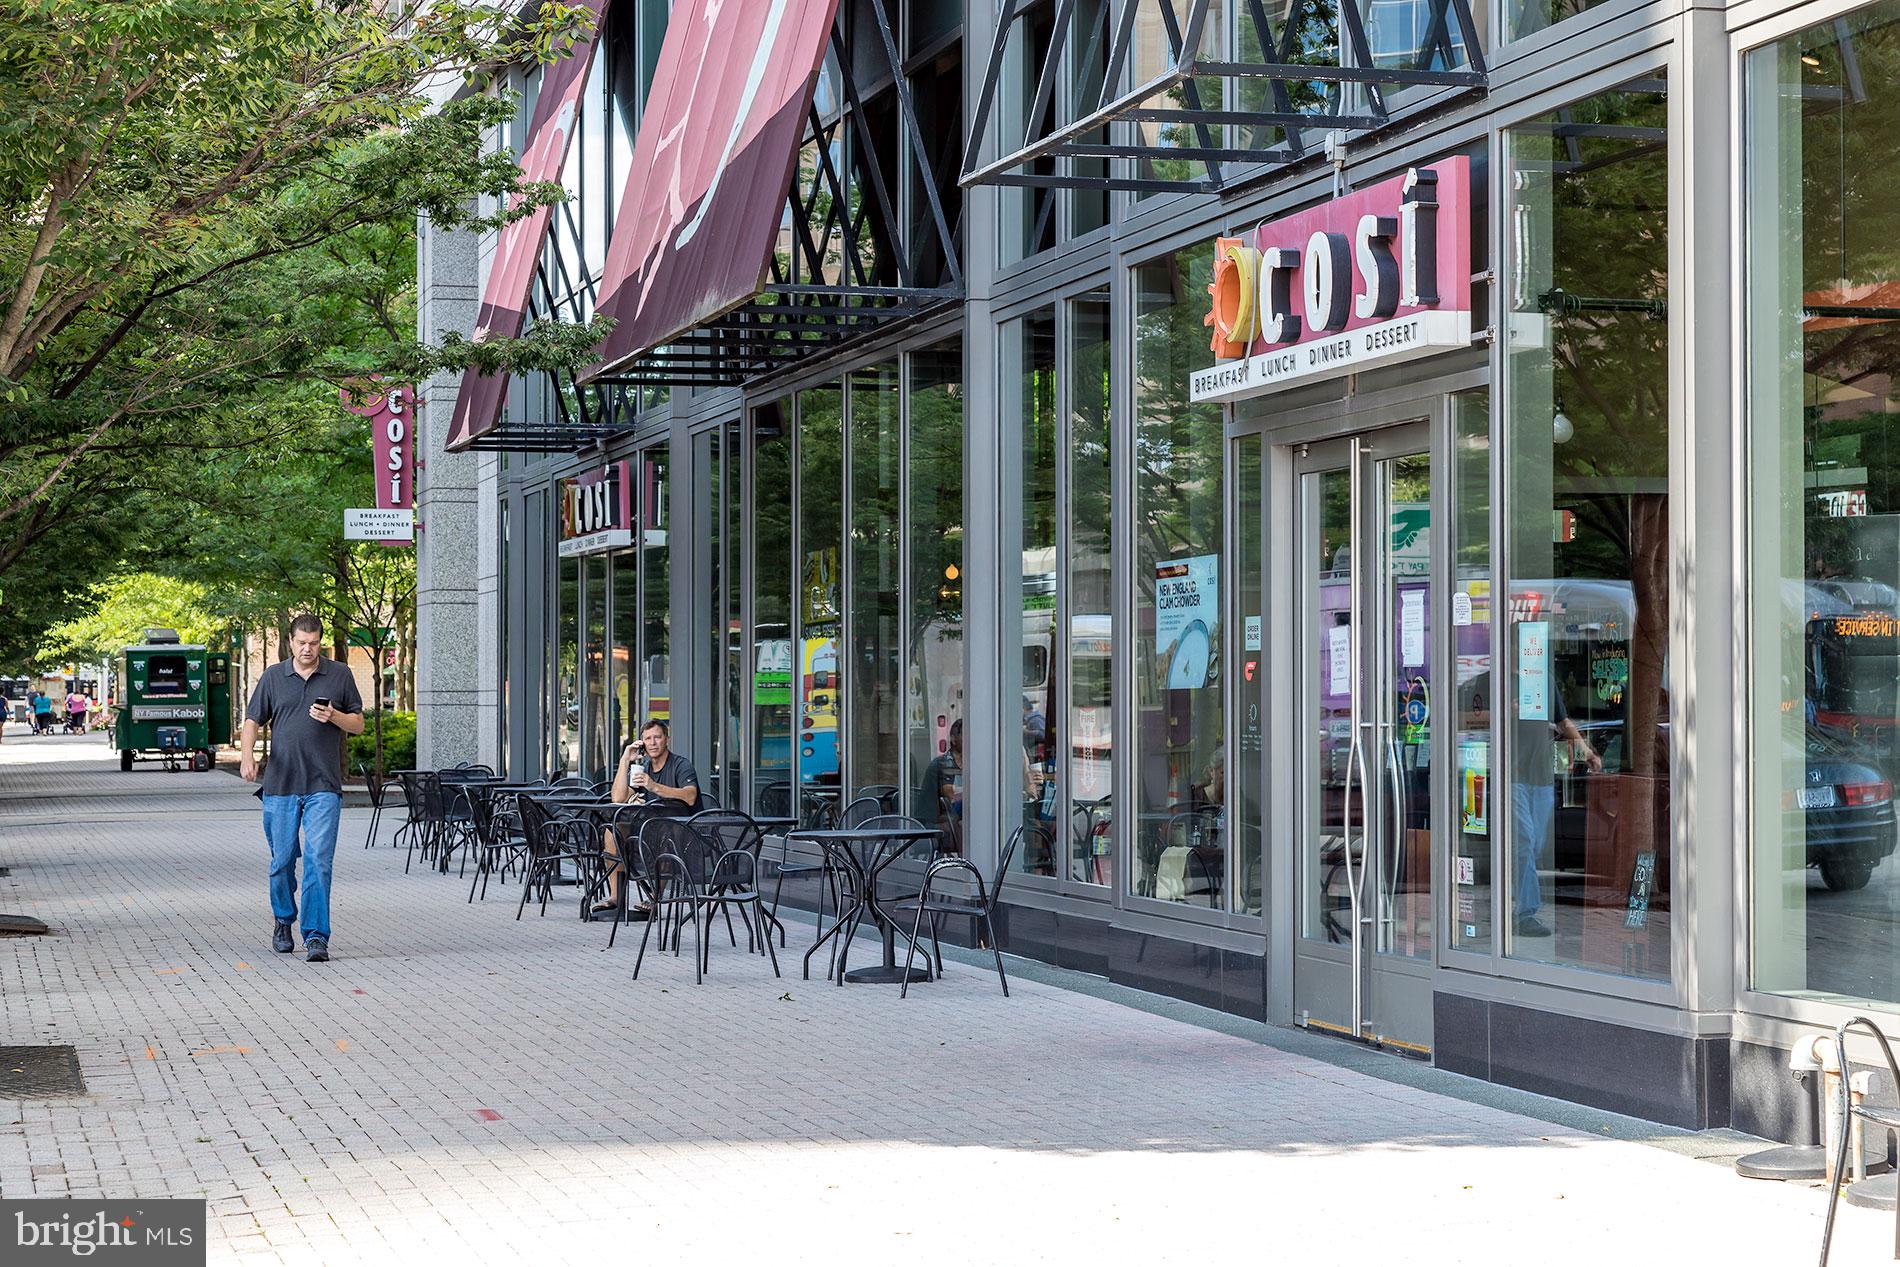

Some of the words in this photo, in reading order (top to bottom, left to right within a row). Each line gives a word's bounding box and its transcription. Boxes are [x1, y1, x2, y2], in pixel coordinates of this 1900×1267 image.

[1194, 364, 1249, 394] BREAKFAST
[1261, 354, 1297, 378] LUNCH
[1309, 340, 1352, 366] DINNER
[1366, 321, 1418, 351] DESSERT
[1159, 583, 1172, 597] NEW
[1172, 580, 1197, 595] ENGLAND
[1159, 596, 1174, 610] CLAM
[1174, 593, 1201, 609] CHOWDER
[145, 709, 173, 718] Famous
[173, 708, 205, 718] Kabob
